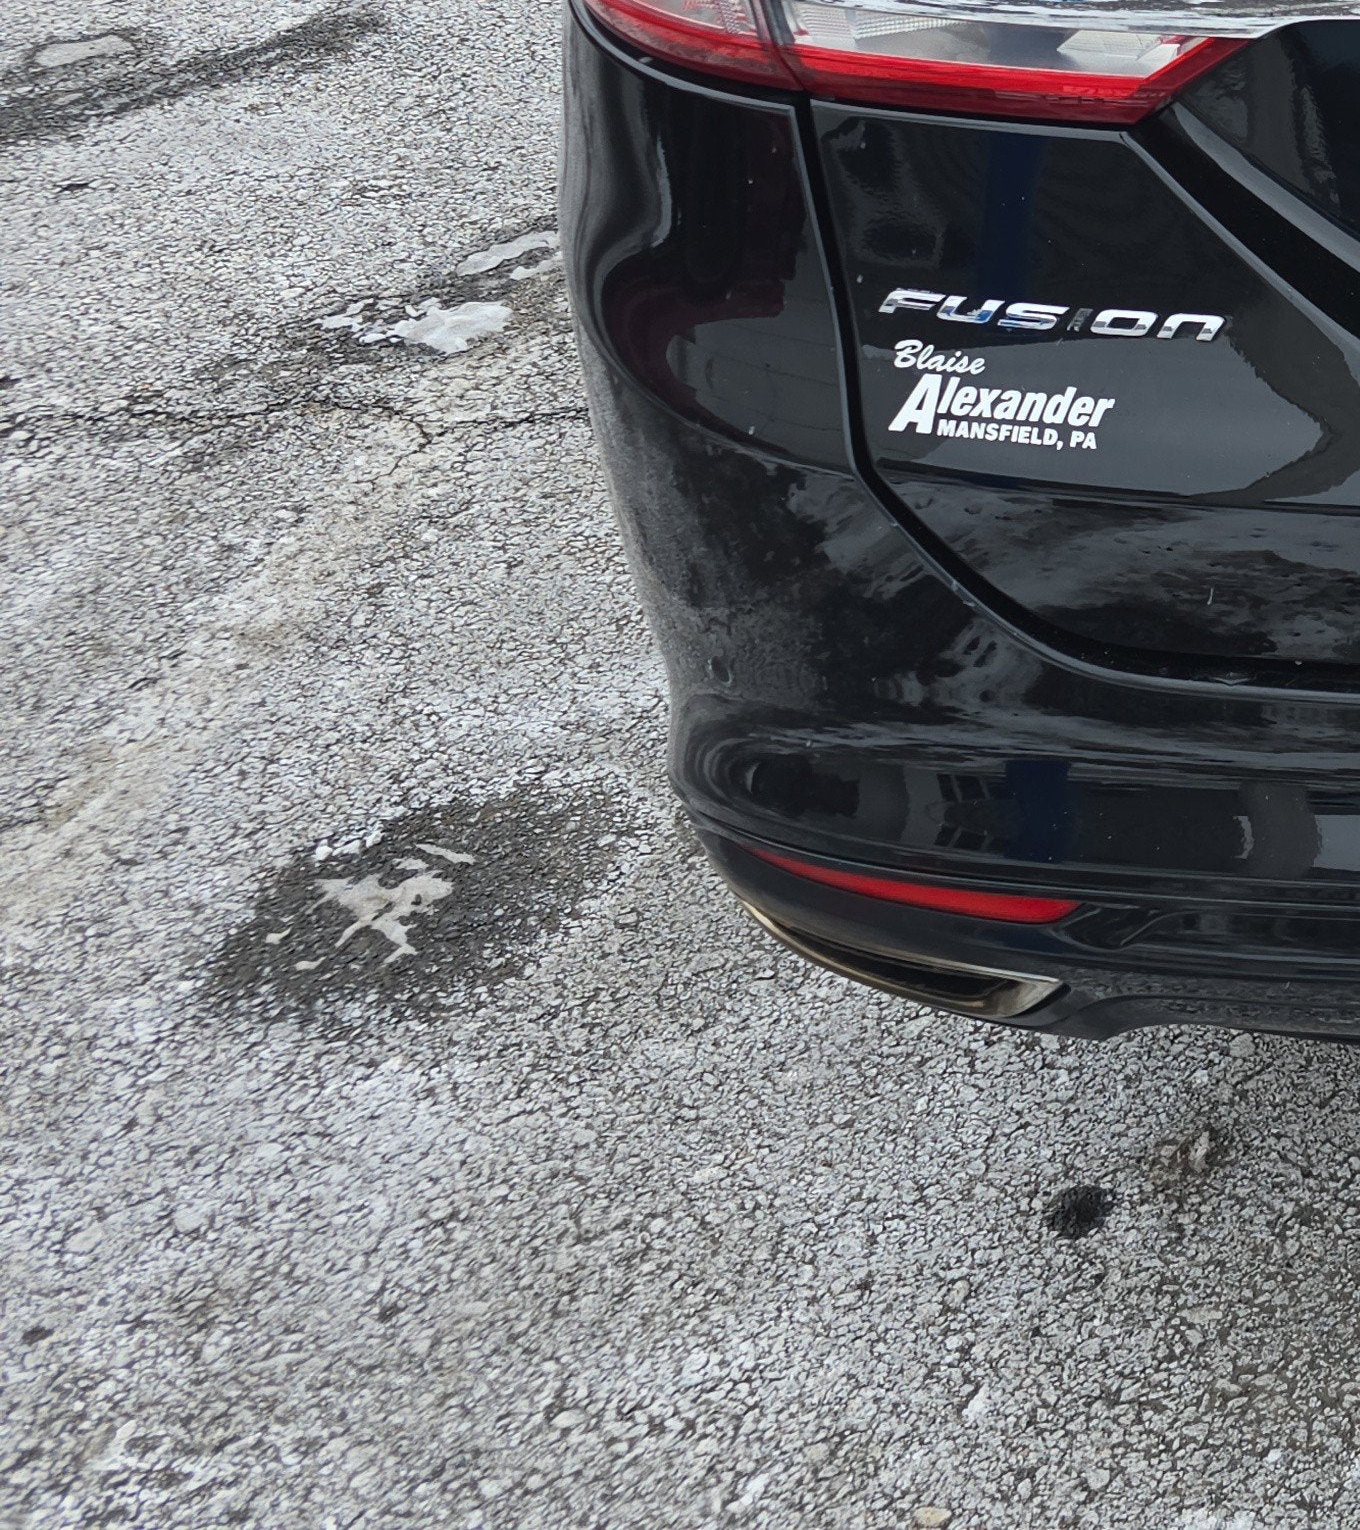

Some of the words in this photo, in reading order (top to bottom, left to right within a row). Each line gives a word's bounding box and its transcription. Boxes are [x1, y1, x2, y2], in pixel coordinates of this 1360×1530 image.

[878, 288, 1227, 342] FUSION
[893, 339, 985, 375] Blaise
[888, 372, 1115, 434] Alexander
[936, 418, 1064, 451] MANSFIELD,
[1069, 430, 1098, 449] PA
